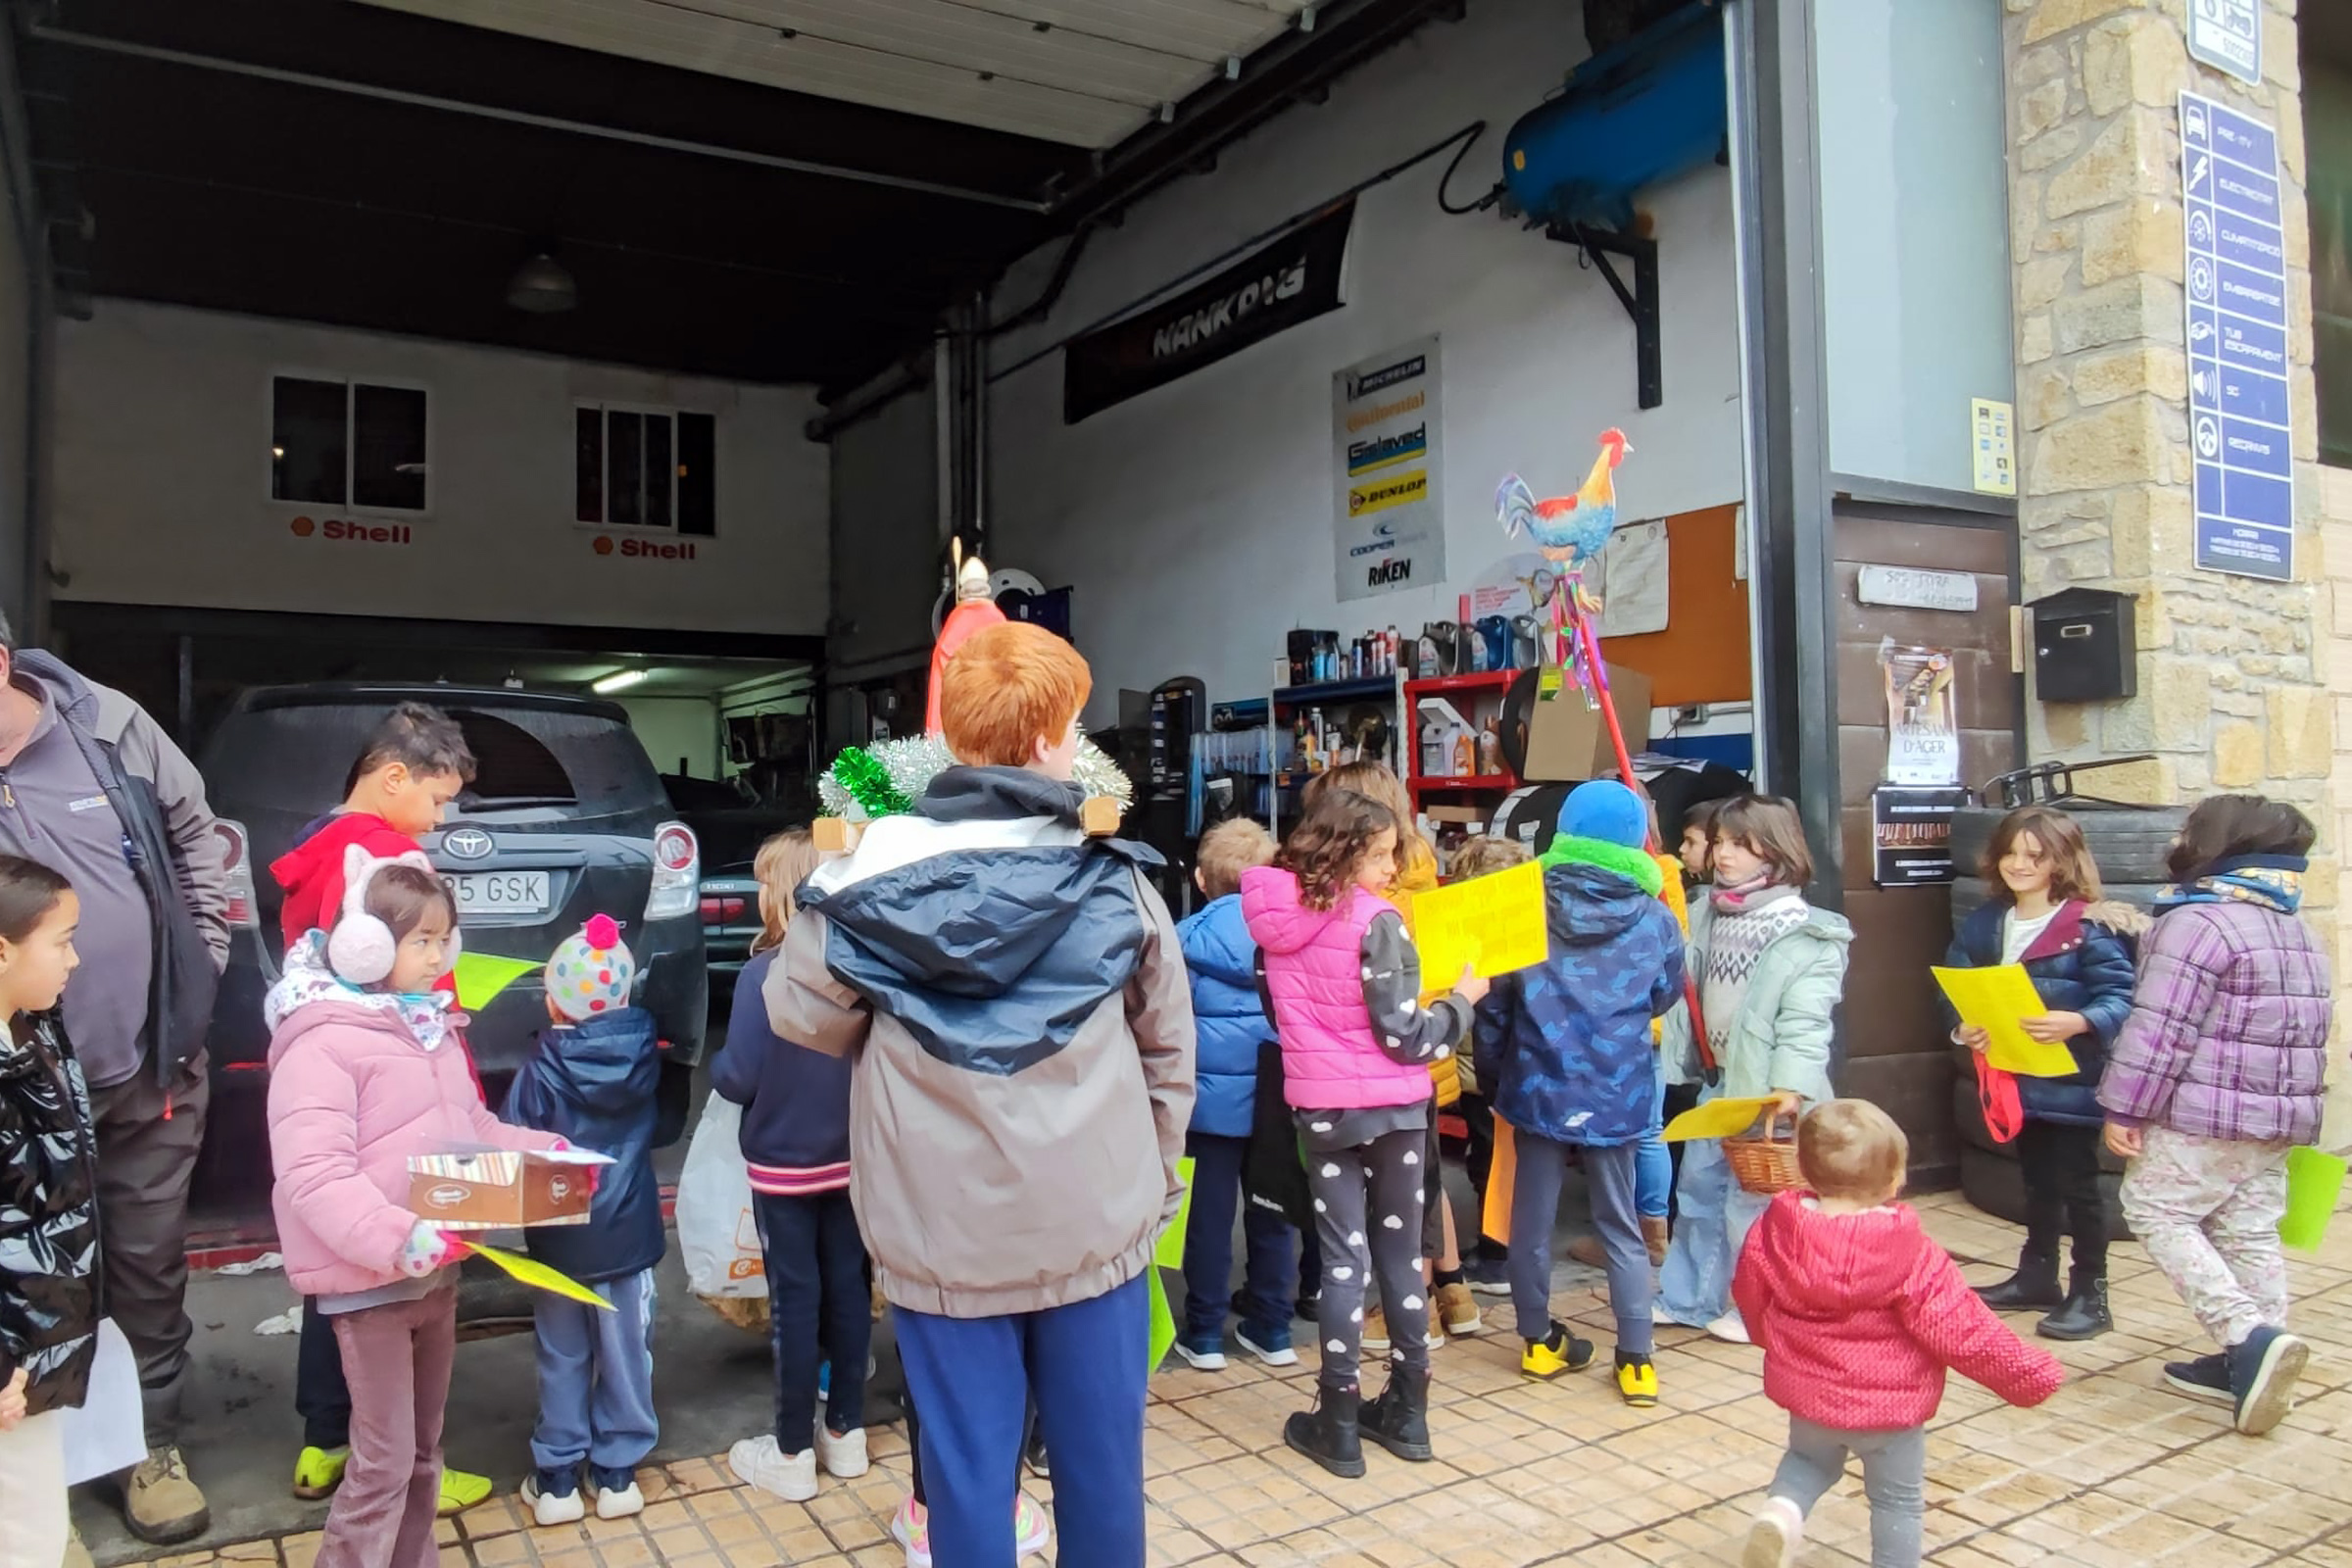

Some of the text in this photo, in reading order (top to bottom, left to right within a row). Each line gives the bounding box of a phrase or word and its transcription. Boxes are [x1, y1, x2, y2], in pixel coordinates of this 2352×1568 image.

[1363, 358, 1423, 389] MICHELIN
[1369, 476, 1426, 502] DUNLOP
[323, 520, 411, 544] Shell
[619, 539, 696, 560] Shell
[1350, 539, 1395, 557] COOPER
[1368, 558, 1411, 587] RIKEN
[487, 876, 540, 902] GSK
